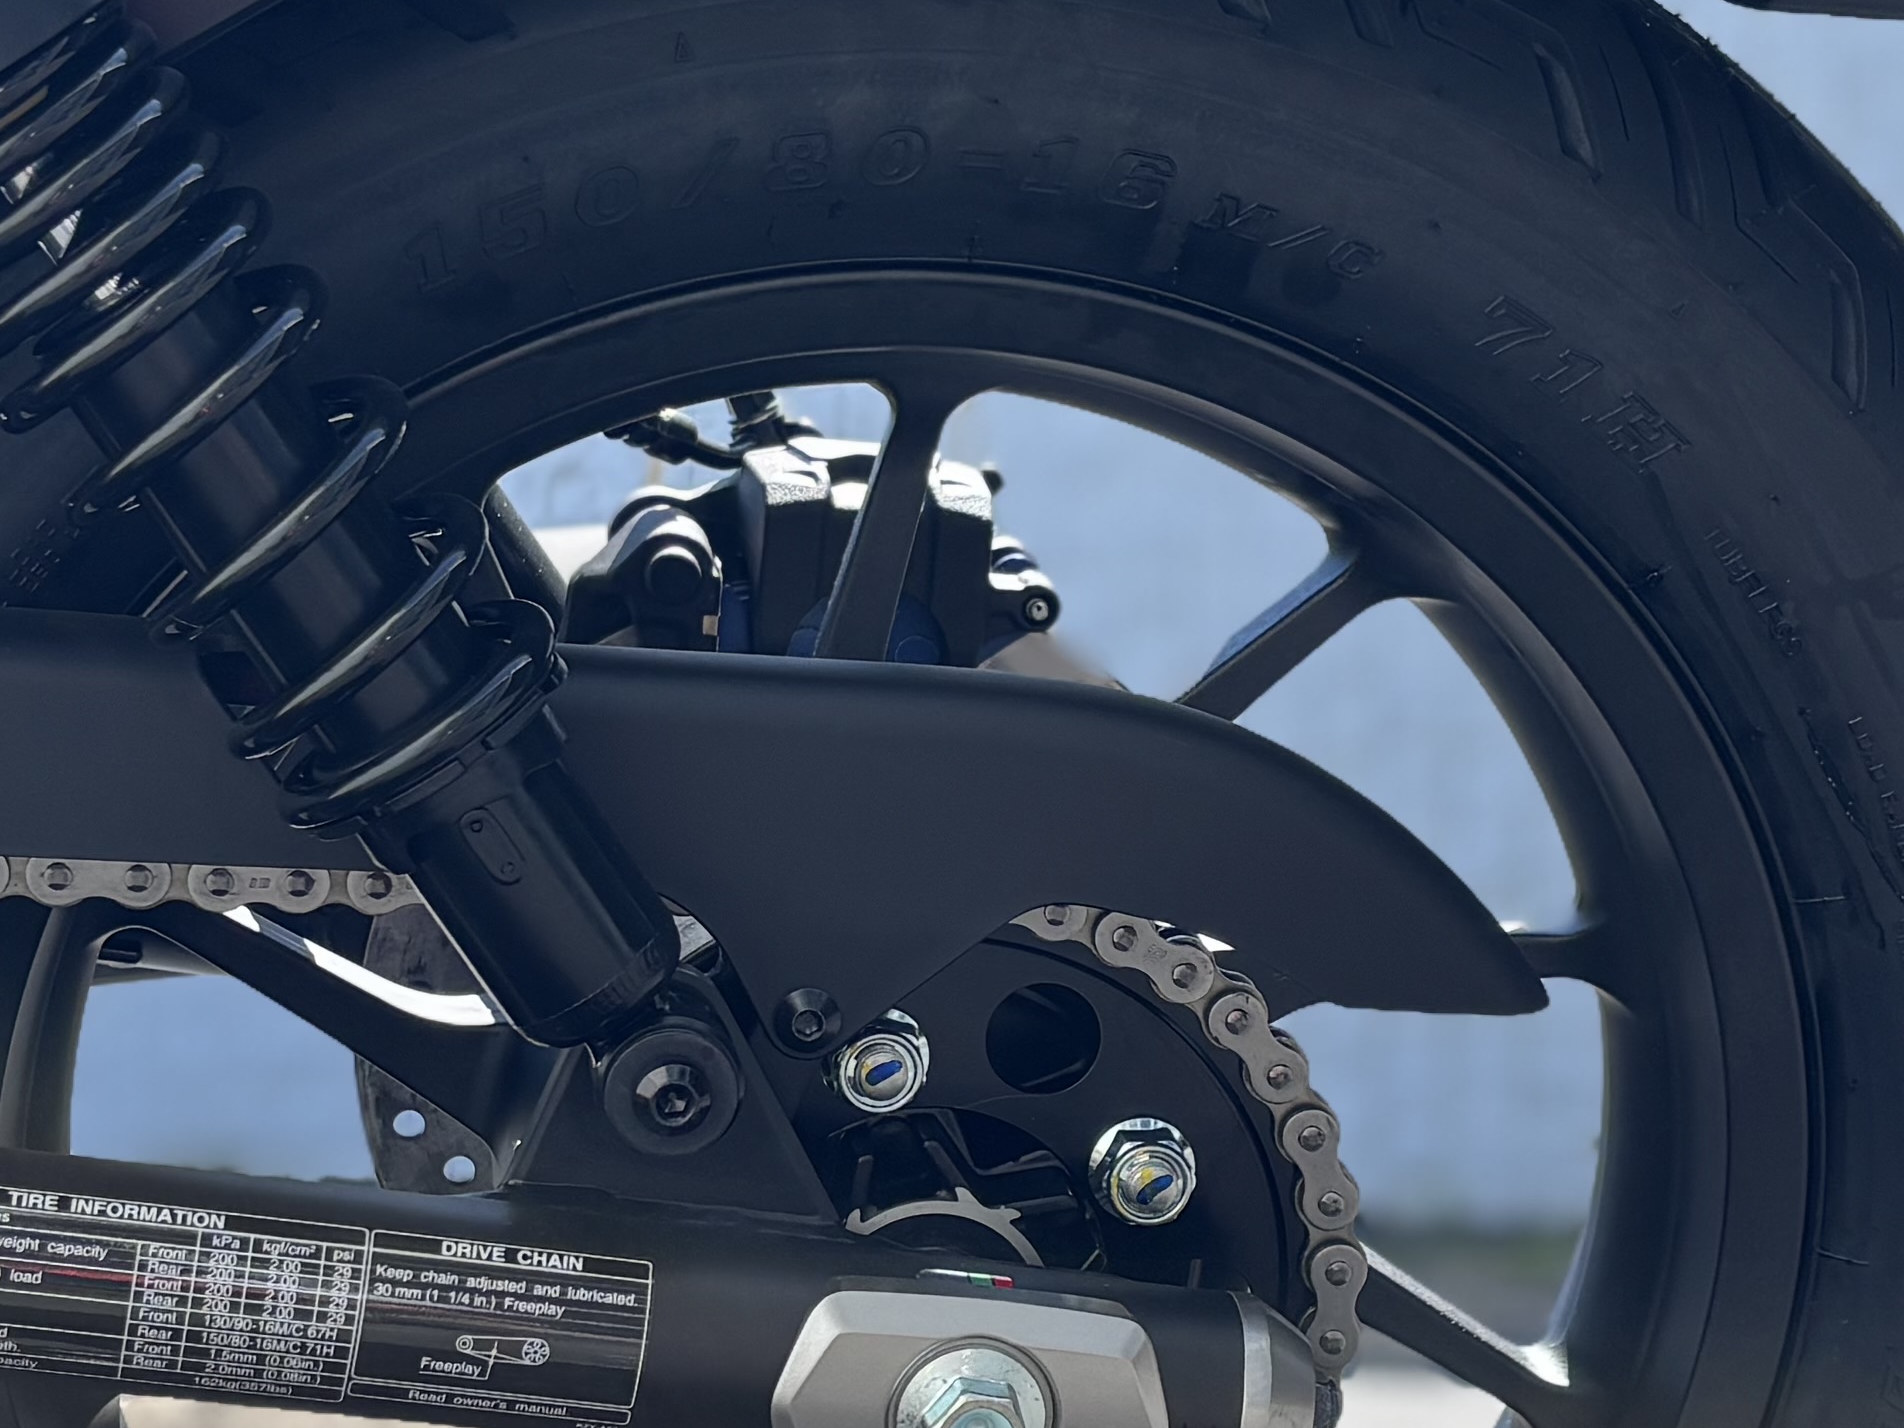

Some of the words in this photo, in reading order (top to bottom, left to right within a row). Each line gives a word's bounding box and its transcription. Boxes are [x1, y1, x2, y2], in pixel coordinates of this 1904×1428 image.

[8, 1191, 59, 1210] TIRE
[71, 1199, 225, 1229] INFORMATION
[47, 1242, 108, 1261] capacity
[149, 1246, 187, 1260] Front
[209, 1253, 237, 1266] 200
[335, 1267, 352, 1279] 29
[212, 1235, 241, 1249] kPa
[333, 1250, 354, 1262] psi
[441, 1242, 506, 1262] DRIVE
[518, 1250, 583, 1271] CHAIN
[10, 1269, 42, 1284] load
[148, 1262, 182, 1275] Rear
[207, 1268, 235, 1281] 200
[332, 1281, 350, 1294] 29
[376, 1264, 414, 1281] Keep
[420, 1268, 458, 1285] chain
[466, 1275, 526, 1294] adjusted
[533, 1283, 560, 1297] and
[144, 1277, 182, 1291] Front
[205, 1284, 233, 1297] 200
[330, 1298, 348, 1309] 29
[373, 1283, 392, 1296] 30
[395, 1288, 422, 1300] mm
[504, 1298, 566, 1319] Freeplay
[139, 1309, 176, 1323] Front
[308, 1327, 337, 1340] 67H
[143, 1293, 179, 1306] Rear
[202, 1299, 230, 1312] 200
[262, 1306, 294, 1319] 2.00
[327, 1313, 345, 1325] 29
[134, 1342, 171, 1355] Front
[137, 1325, 173, 1339] Rear
[306, 1343, 335, 1356] 71H
[133, 1357, 168, 1368] Rear
[420, 1357, 482, 1376] Freeplay
[408, 1390, 446, 1403] Read
[454, 1396, 507, 1409] owner's
